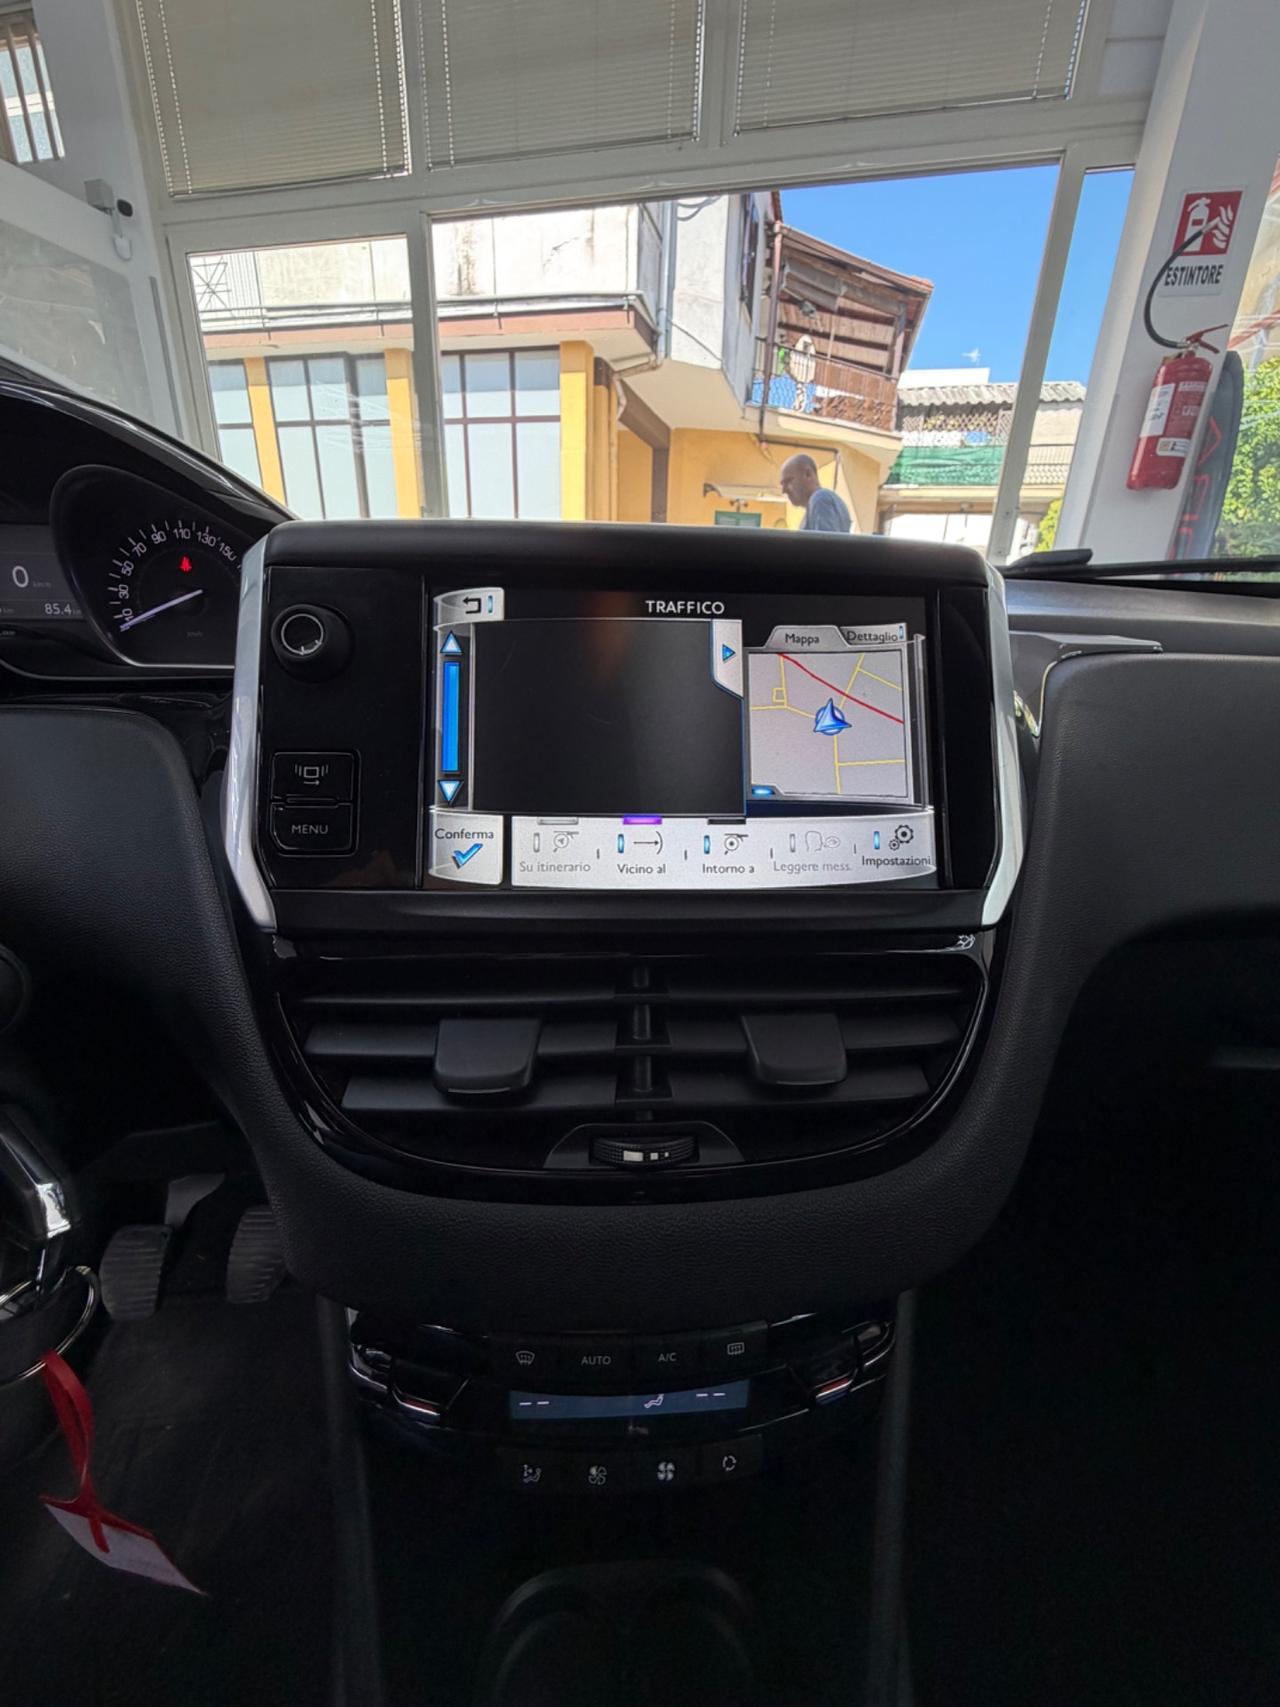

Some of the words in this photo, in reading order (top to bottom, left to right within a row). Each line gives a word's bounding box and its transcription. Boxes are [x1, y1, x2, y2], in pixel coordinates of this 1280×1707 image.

[1164, 264, 1224, 286] ESTINTORE
[151, 531, 167, 544] 90
[173, 528, 191, 540] 110
[197, 531, 217, 548] 130
[132, 543, 147, 557] 70
[121, 560, 134, 576] 50
[12, 565, 29, 588] 0
[118, 584, 130, 599] 30
[44, 603, 72, 615] 85.4
[645, 600, 725, 615] TRAFFICO
[785, 633, 820, 646] Mappa
[846, 630, 899, 644] Dettaglio
[291, 824, 329, 835] MENU
[434, 828, 495, 840] Conferma
[519, 861, 534, 873] Su
[537, 861, 591, 873] itinerario
[773, 861, 819, 875] Leggere
[822, 864, 853, 873] mess.
[862, 855, 931, 869] Impostazioni
[617, 864, 653, 874] Vicino
[656, 864, 666, 874] al
[702, 864, 746, 875] Intorno
[749, 866, 755, 874] a
[581, 1355, 612, 1366] AUTO
[658, 1352, 677, 1362] A/C
